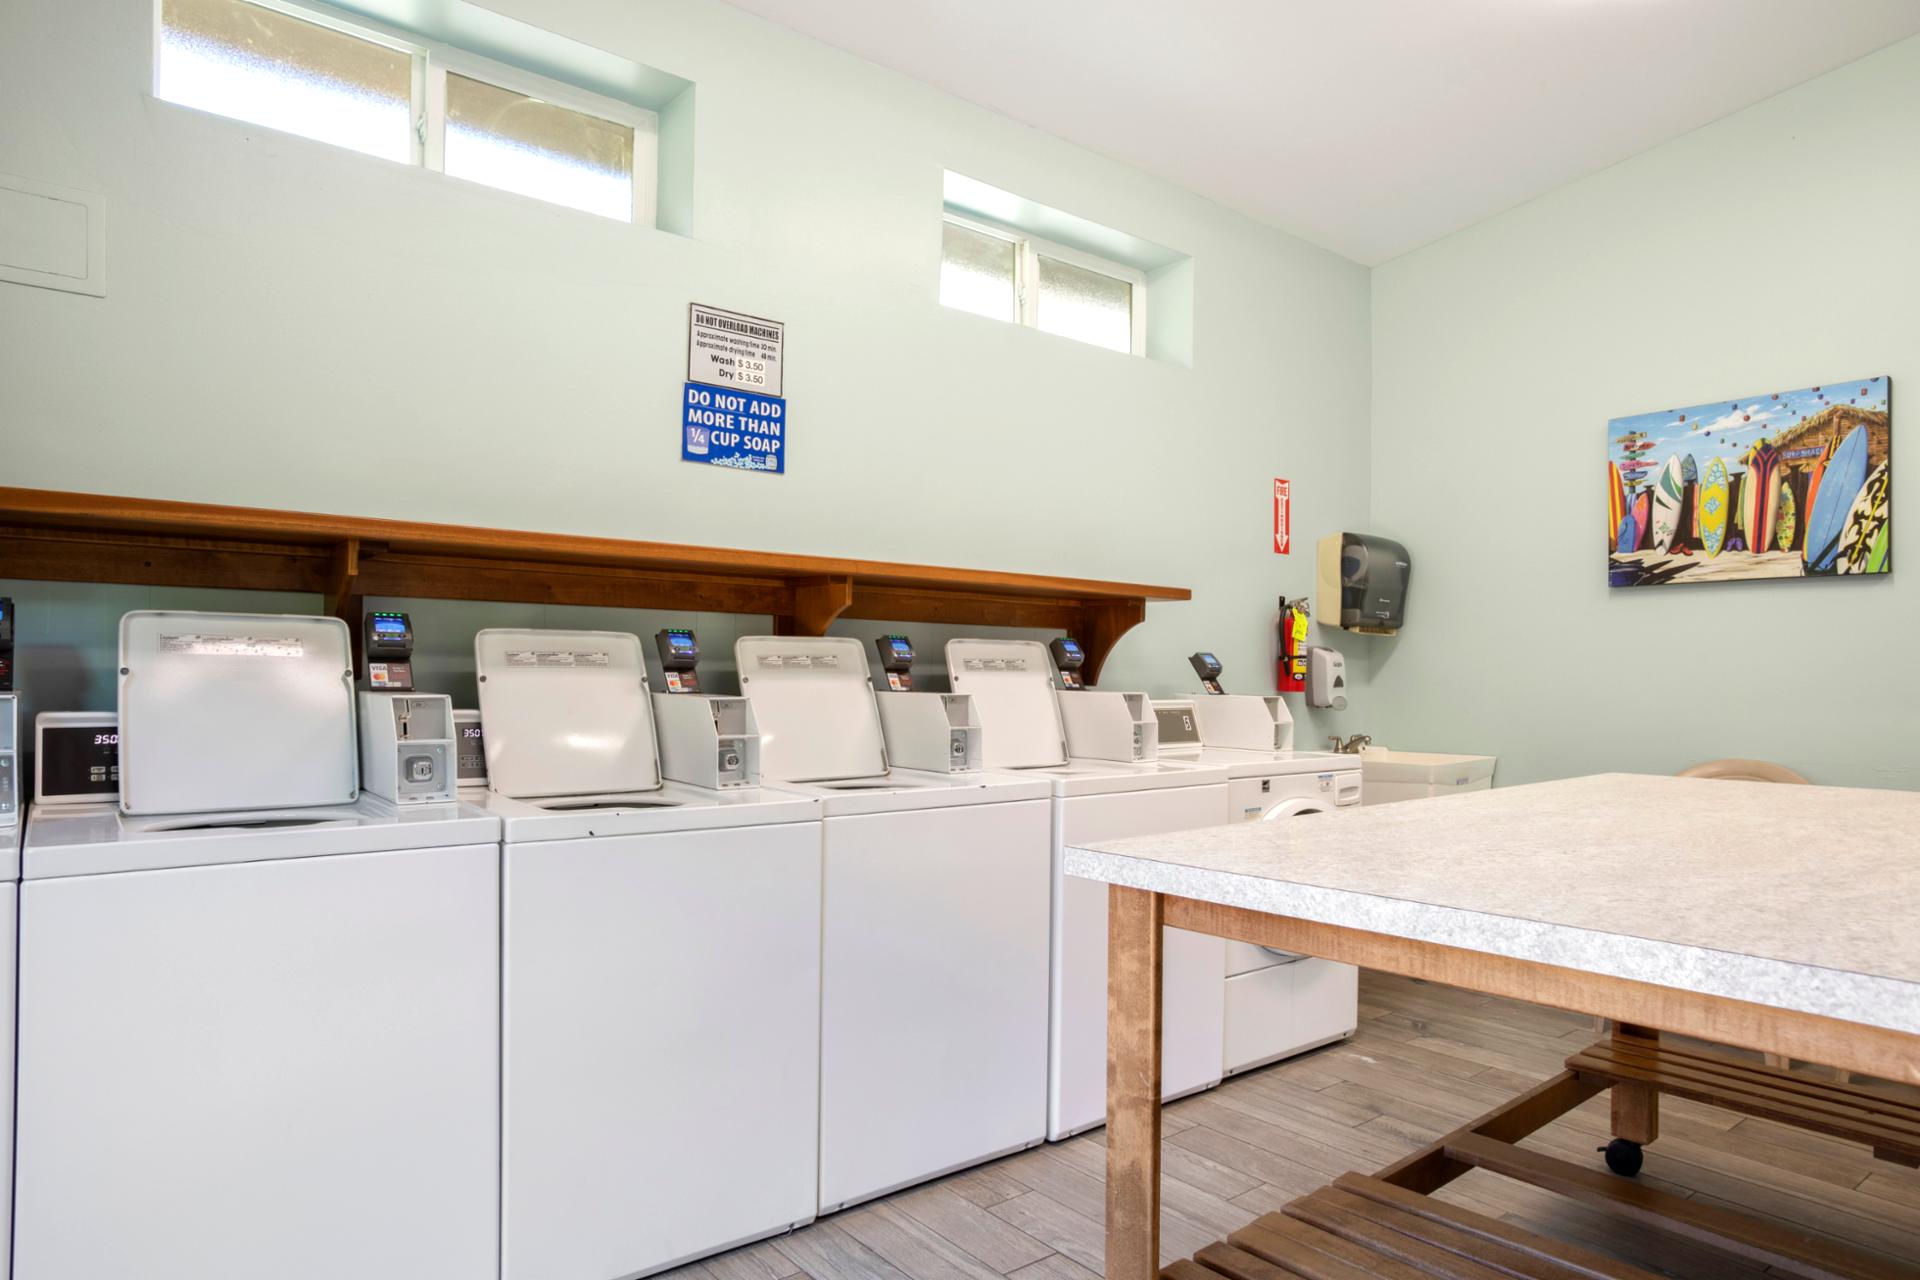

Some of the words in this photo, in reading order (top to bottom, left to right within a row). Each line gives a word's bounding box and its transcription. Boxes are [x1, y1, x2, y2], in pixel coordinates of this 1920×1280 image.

[696, 313, 705, 324] DO
[706, 315, 718, 327] NOT
[718, 318, 748, 334] OVERLOAD
[749, 325, 780, 340] MACHINES
[696, 340, 728, 352] Approximate
[729, 347, 745, 357] drying
[697, 330, 729, 343] Approximate
[730, 338, 749, 348] washing
[711, 354, 735, 366] Wash
[719, 369, 734, 380] Dry
[688, 389, 711, 406] DO
[715, 394, 747, 412] NOT
[749, 400, 781, 418] ADD
[688, 408, 735, 429] MORE
[738, 416, 781, 436] THAN
[710, 430, 740, 447] CUP
[743, 435, 781, 453] SOAP
